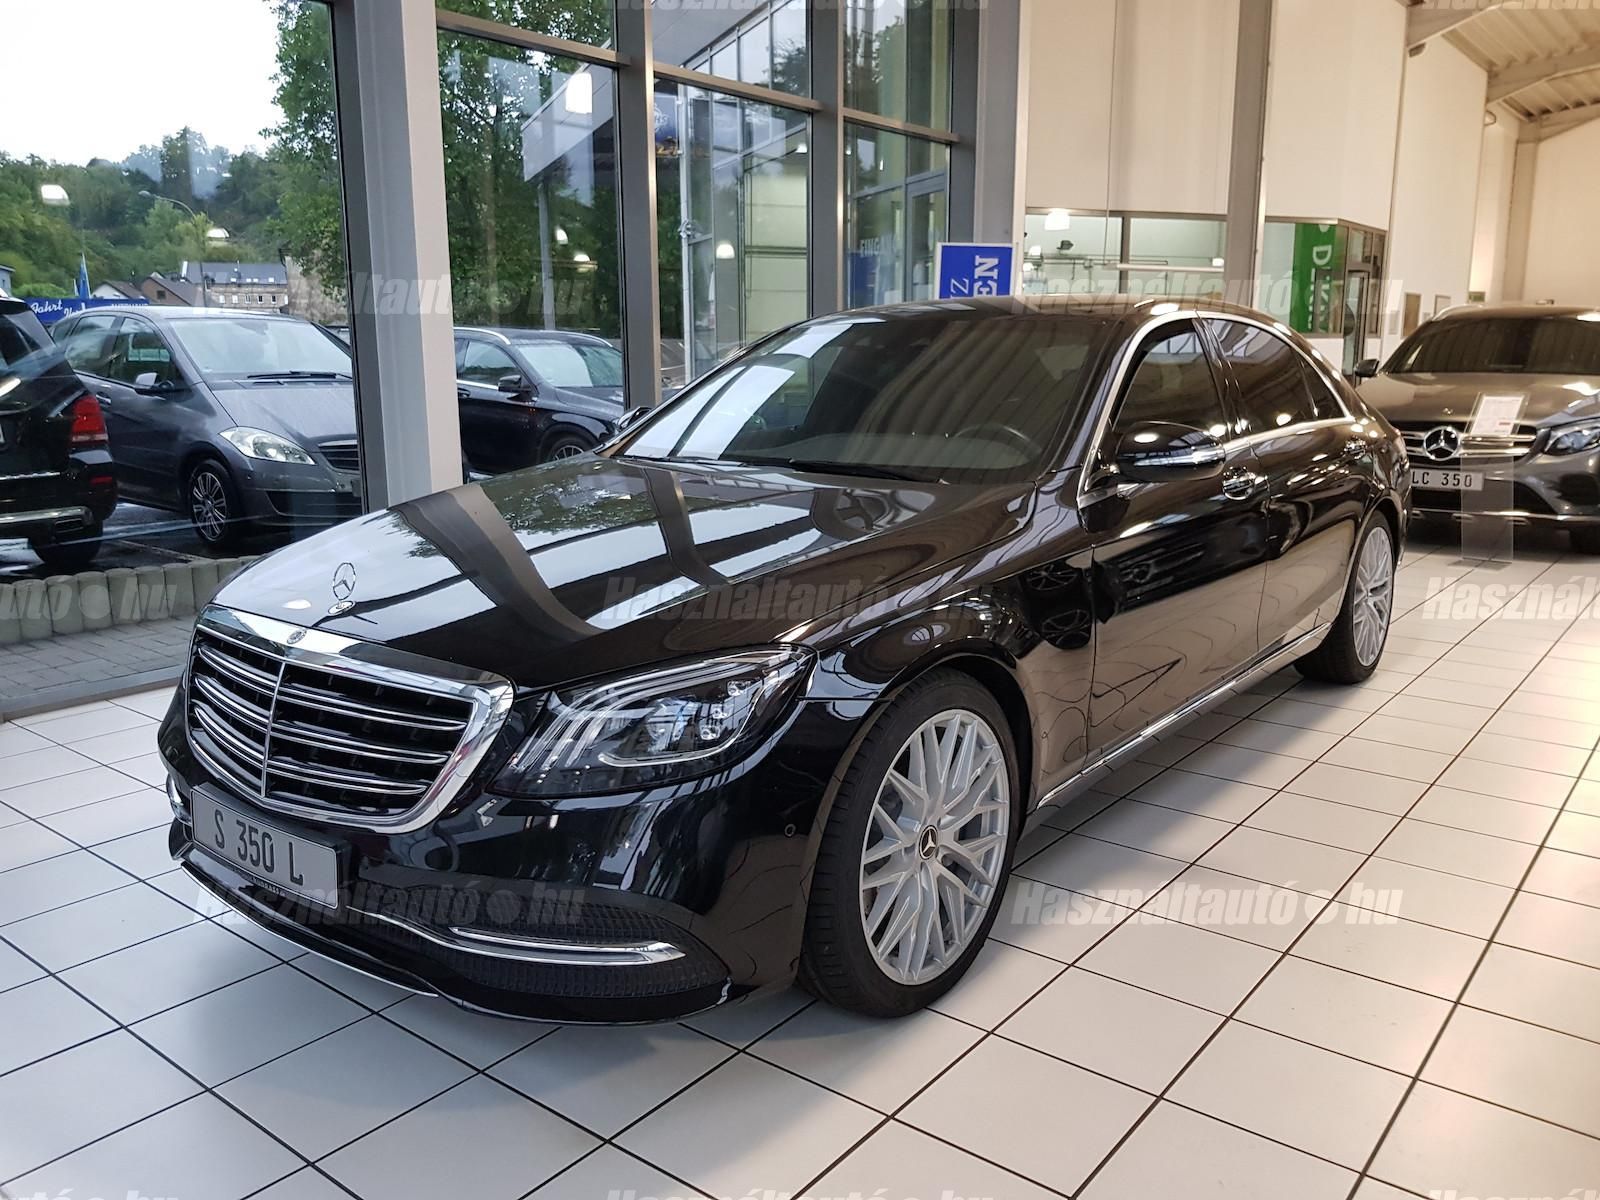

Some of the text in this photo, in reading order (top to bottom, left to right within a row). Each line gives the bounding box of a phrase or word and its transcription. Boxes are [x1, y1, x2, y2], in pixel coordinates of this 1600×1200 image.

[1441, 473, 1472, 488] 350
[214, 809, 225, 849] S
[236, 820, 274, 873] 350
[289, 841, 303, 886] L
